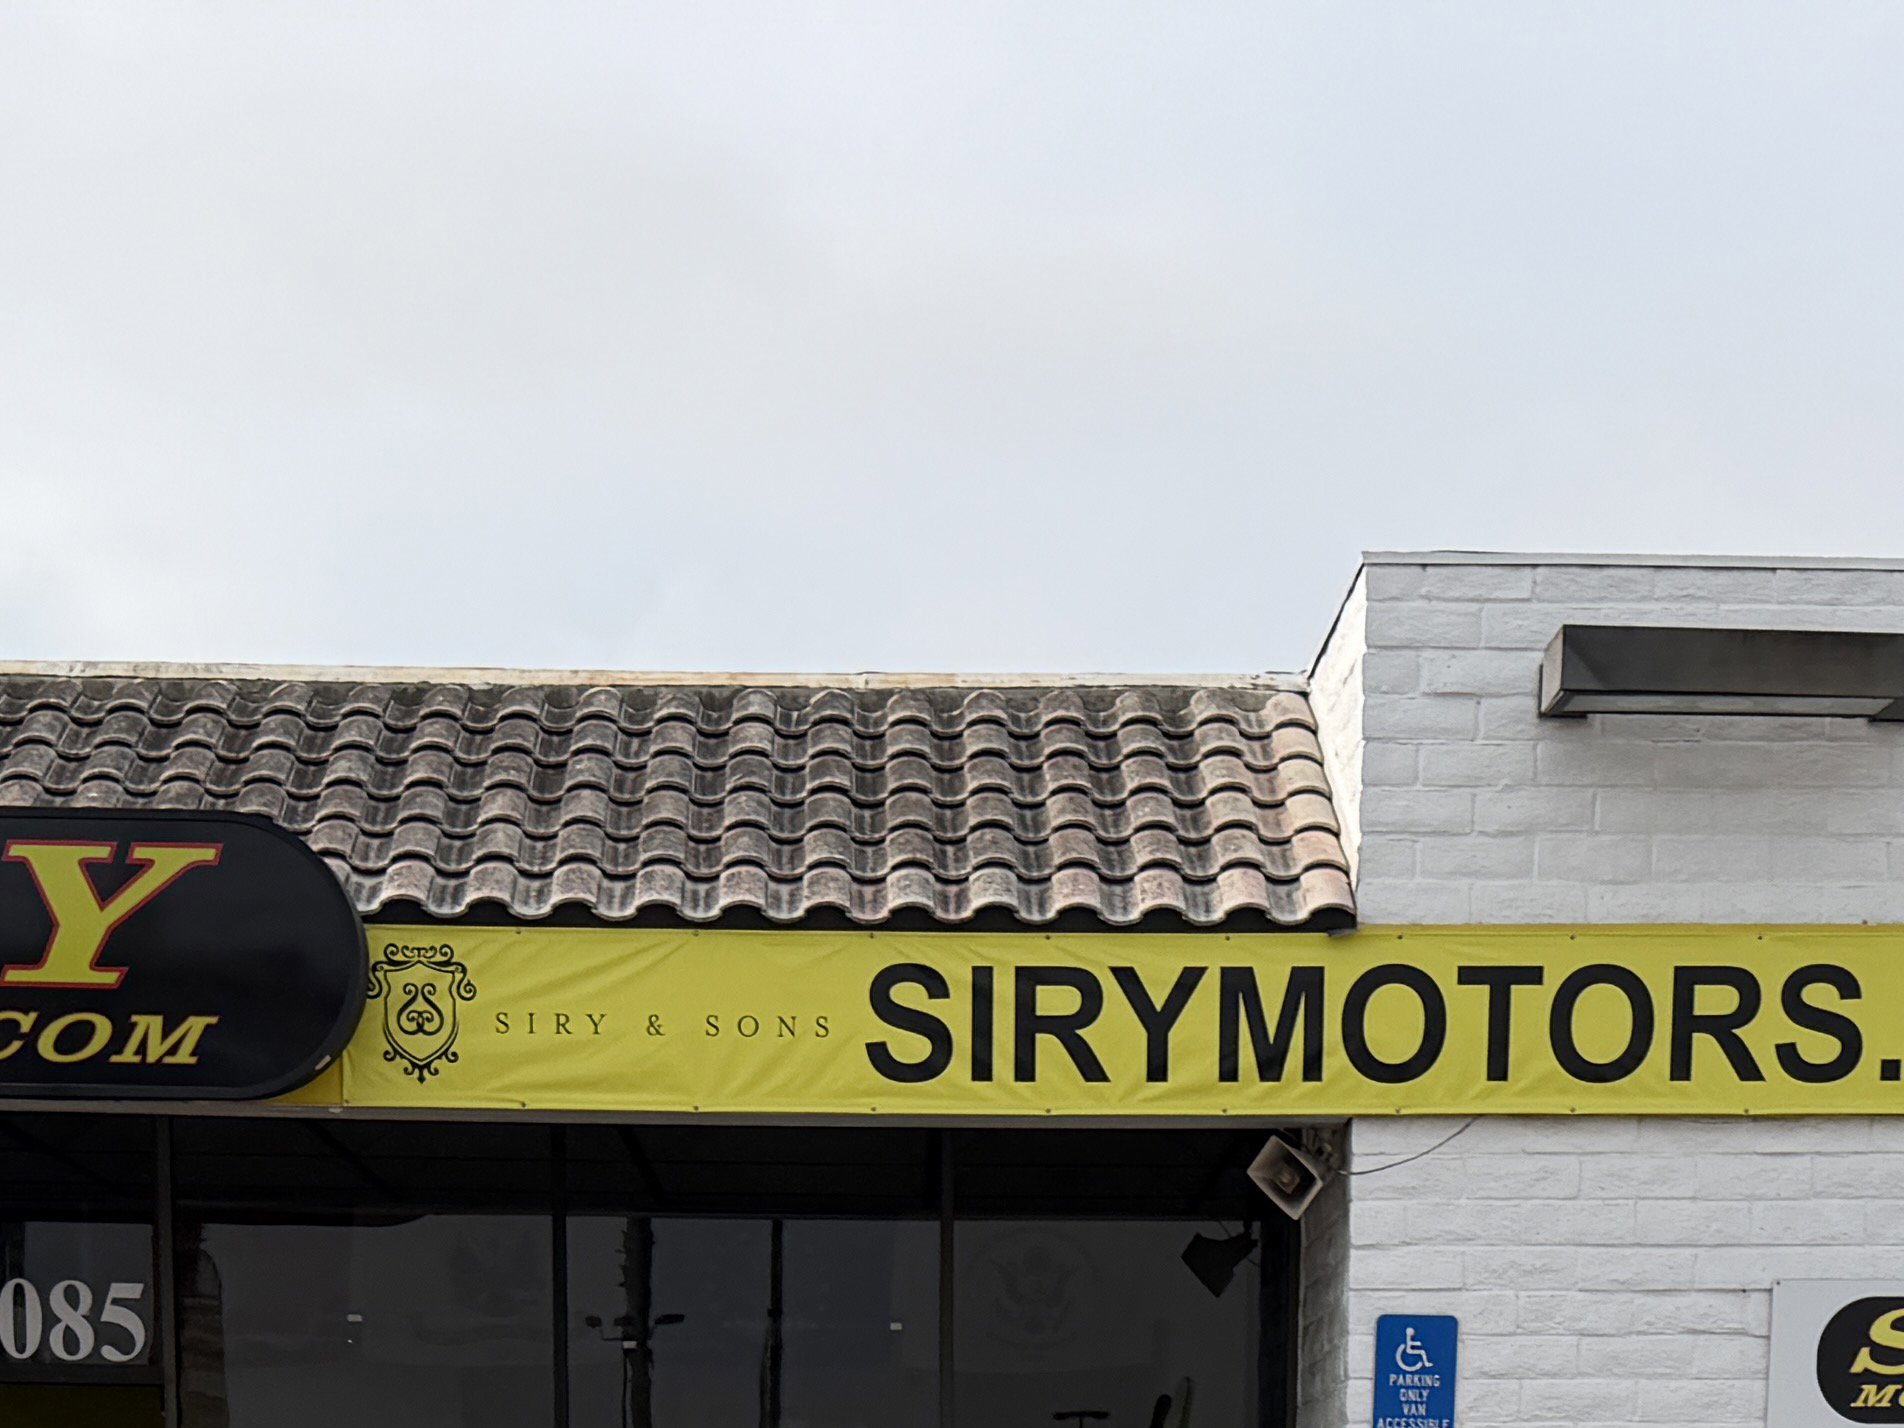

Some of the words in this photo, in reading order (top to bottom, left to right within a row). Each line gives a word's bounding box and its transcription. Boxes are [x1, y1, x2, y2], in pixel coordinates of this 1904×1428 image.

[495, 1011, 608, 1035] SIRY
[645, 1013, 667, 1037] &
[704, 1014, 831, 1038] SONS
[1388, 1373, 1441, 1387] PARKING
[1399, 1388, 1430, 1402] ONLY
[1402, 1403, 1427, 1416] VAN
